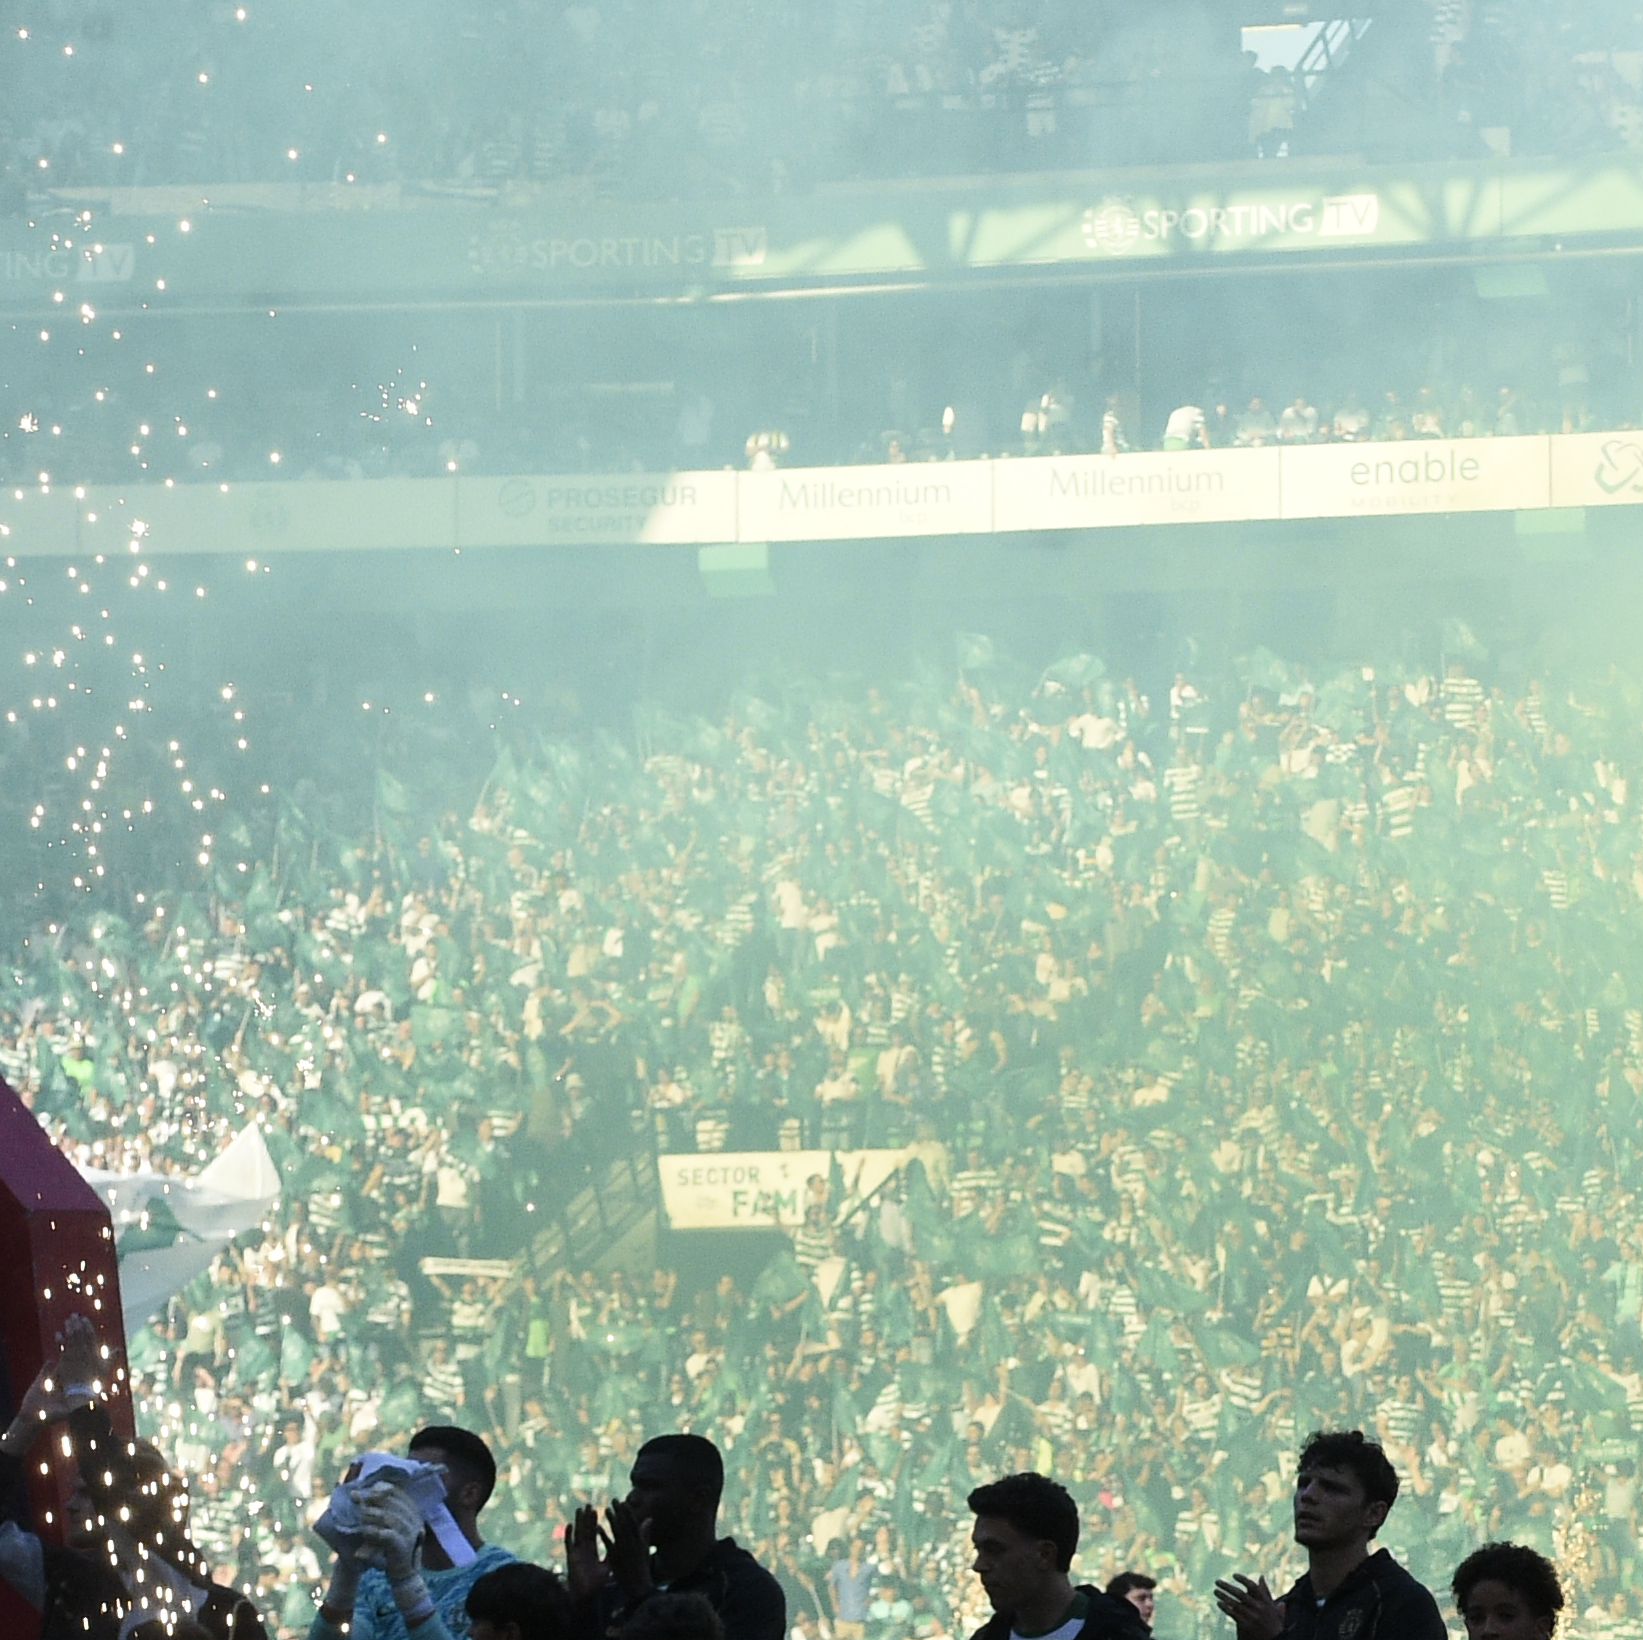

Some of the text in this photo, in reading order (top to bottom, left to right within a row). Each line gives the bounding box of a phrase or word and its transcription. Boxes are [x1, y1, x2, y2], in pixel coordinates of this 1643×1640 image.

[1141, 200, 1372, 240] SPORTING TV
[530, 231, 764, 269] SPORTING TV
[1048, 466, 1225, 498] Millennium
[1349, 450, 1481, 486] enable
[546, 486, 697, 509] PROSEGUR
[778, 479, 952, 511] Millennium
[547, 514, 649, 534] SECURITY
[676, 1165, 761, 1187] SECTOR
